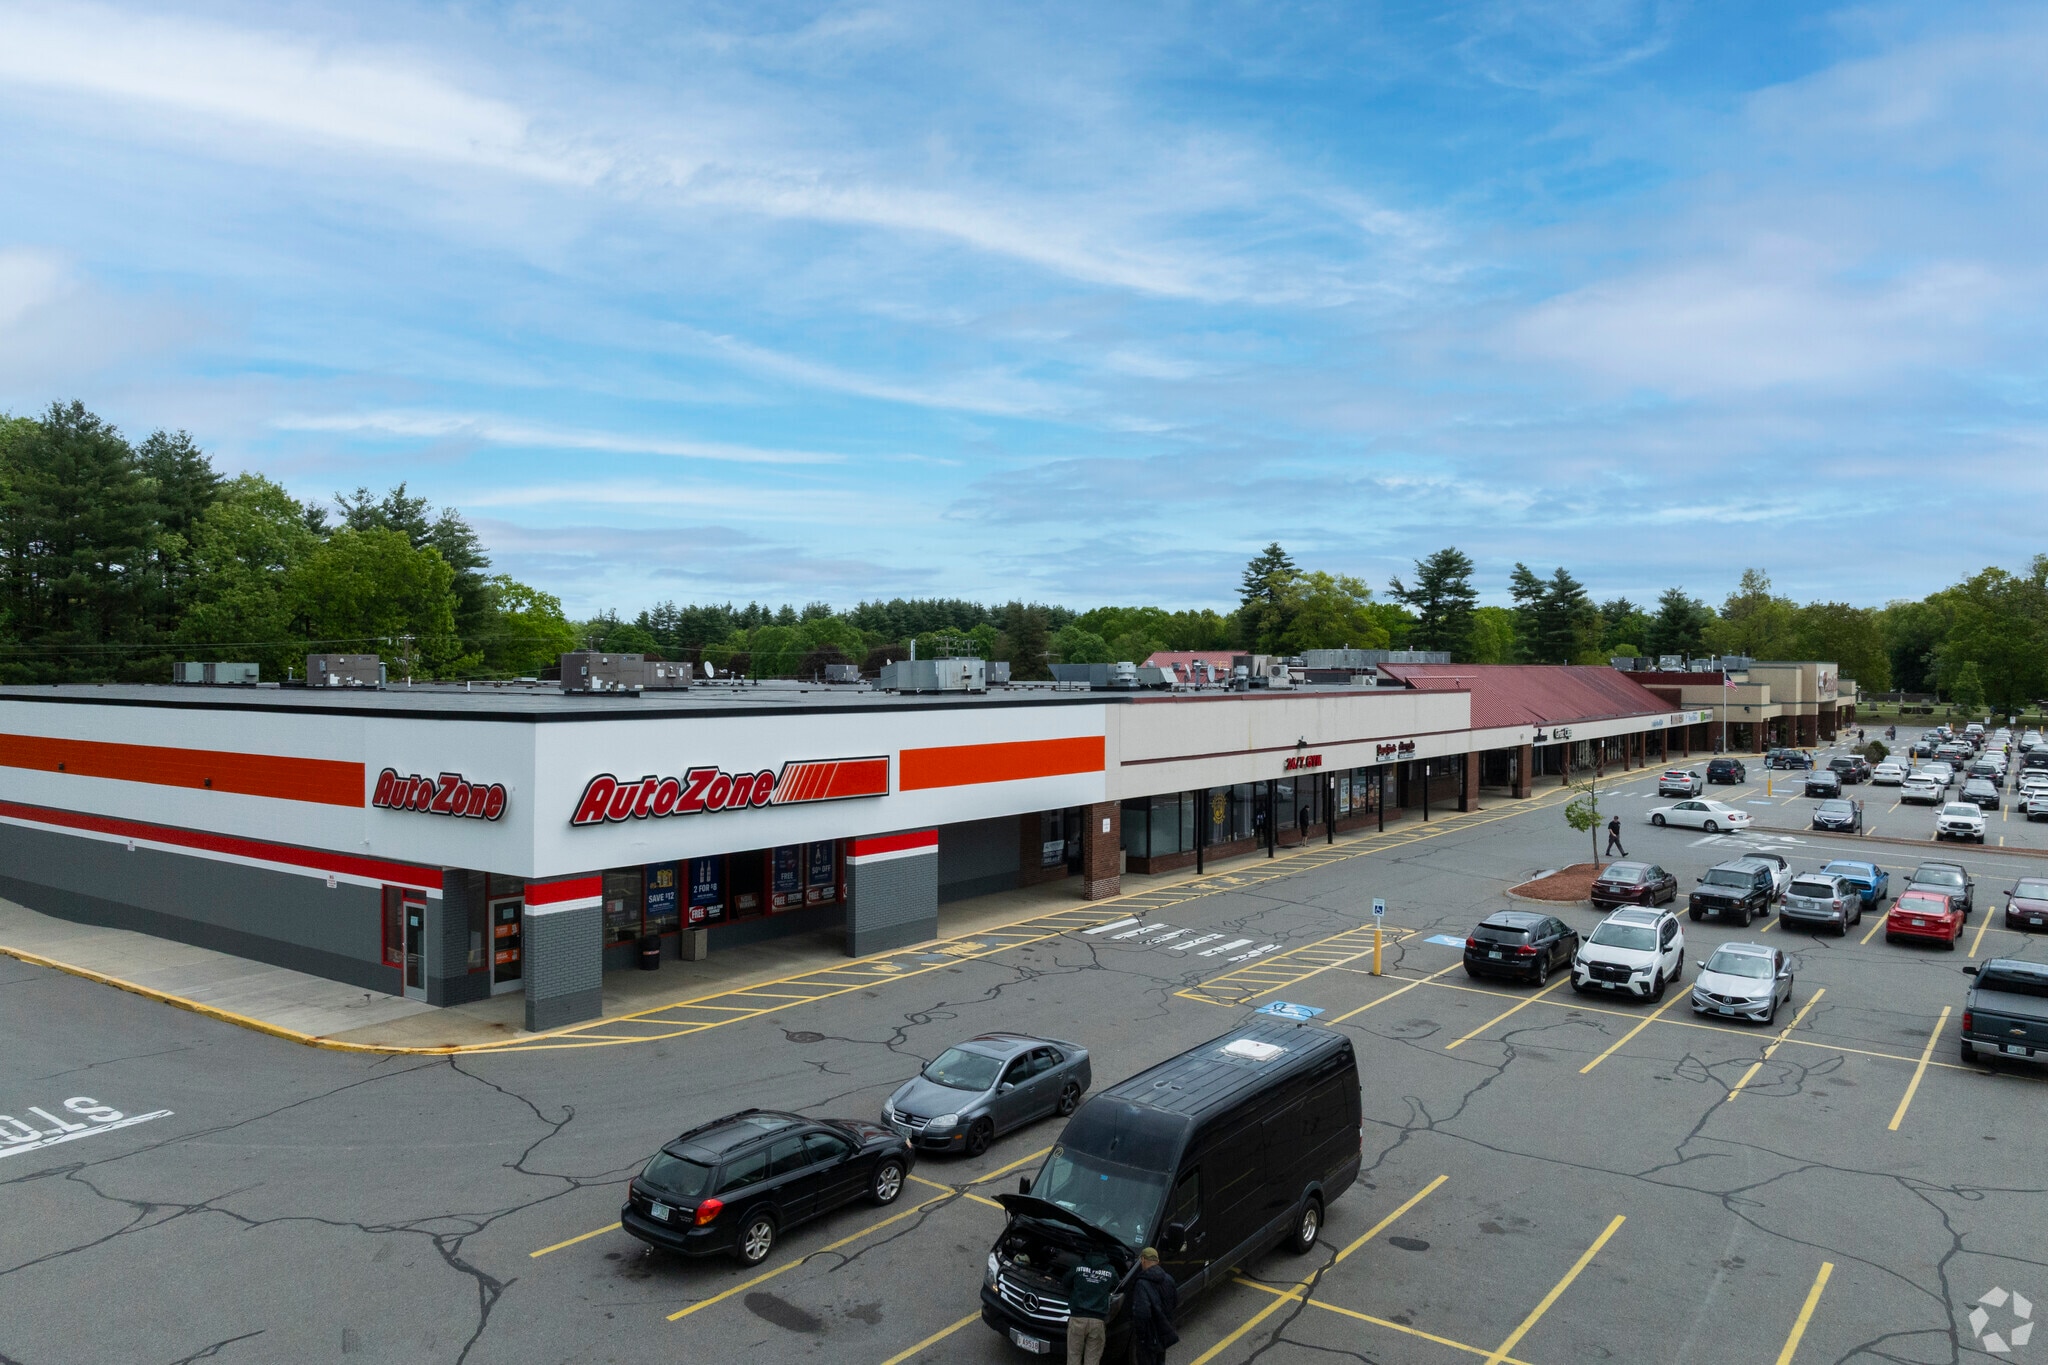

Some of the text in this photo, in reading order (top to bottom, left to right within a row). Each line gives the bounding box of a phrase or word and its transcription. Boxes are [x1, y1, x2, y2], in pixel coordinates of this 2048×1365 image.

[1306, 754, 1322, 768] GYM
[373, 768, 507, 821] AutoZone
[572, 766, 777, 826] AutoZone
[780, 871, 794, 880] FREE
[648, 893, 665, 904] SAVE
[774, 896, 786, 906] FREE
[691, 908, 705, 920] FREE
[0, 1096, 124, 1148] STO
